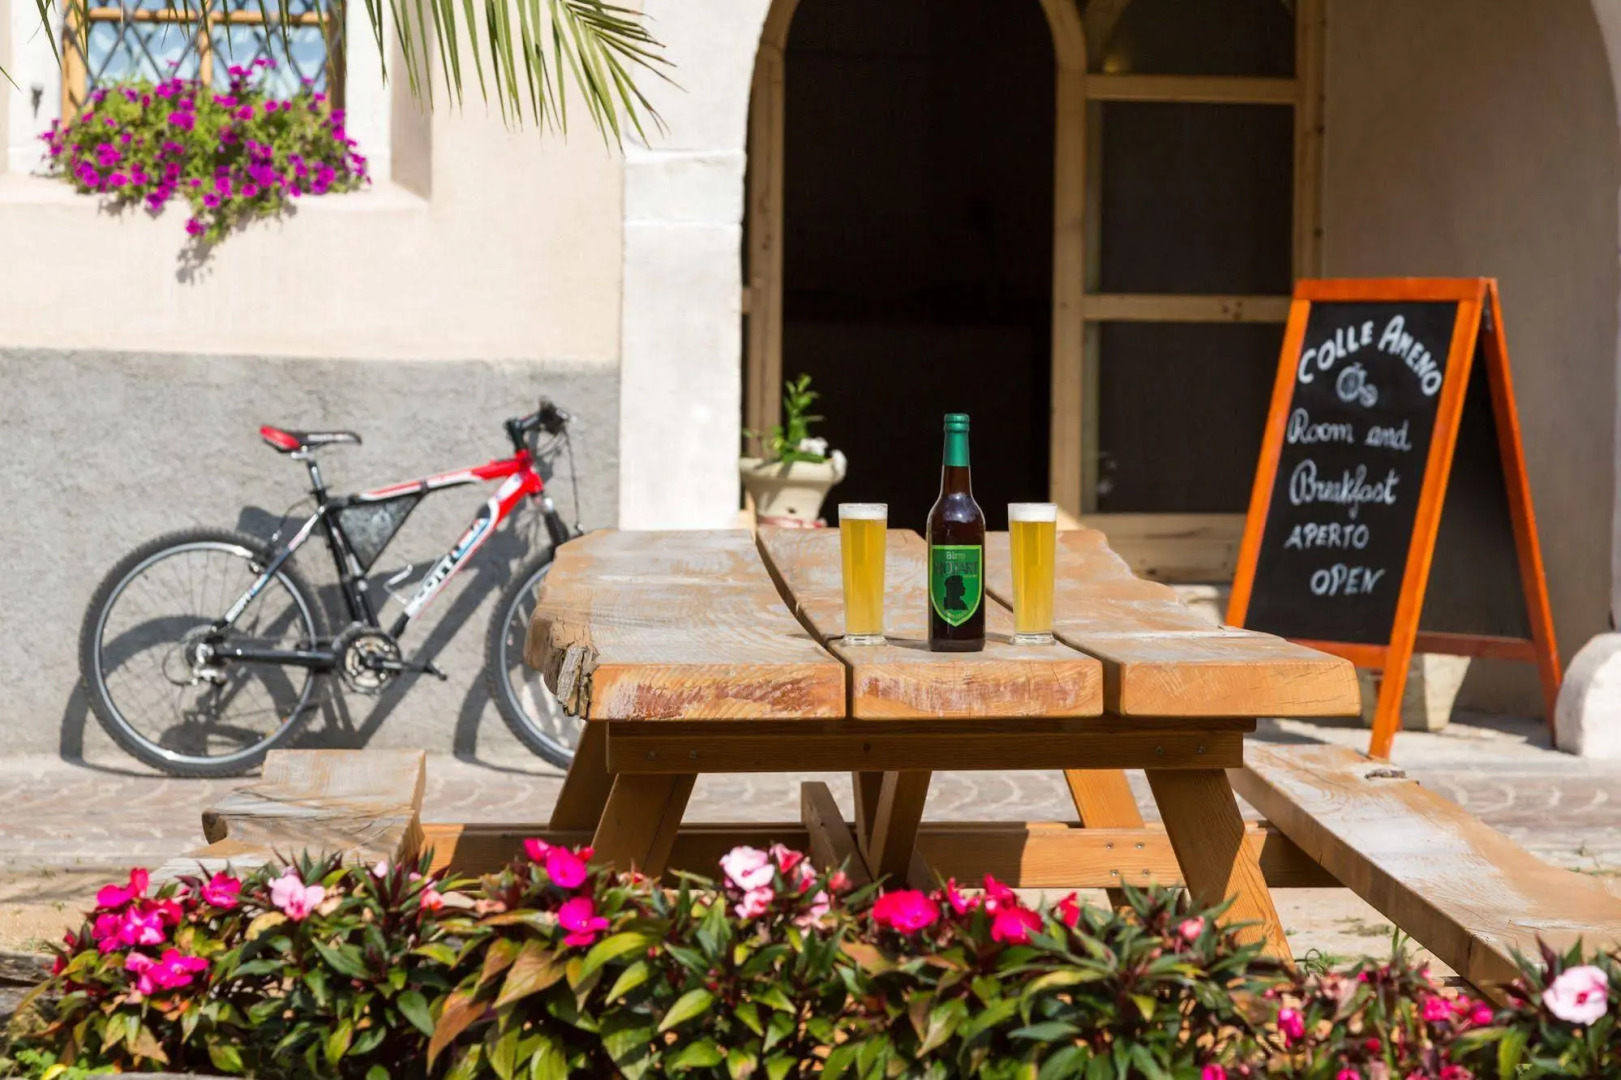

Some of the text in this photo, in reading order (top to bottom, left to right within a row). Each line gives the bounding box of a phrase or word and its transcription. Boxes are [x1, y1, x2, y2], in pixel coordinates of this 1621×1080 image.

[1298, 314, 1442, 396] COLLE AMENO
[1288, 407, 1411, 450] Room and
[1290, 459, 1398, 518] Breakfast
[1284, 523, 1369, 549] APERTO
[1310, 563, 1384, 595] OPEN
